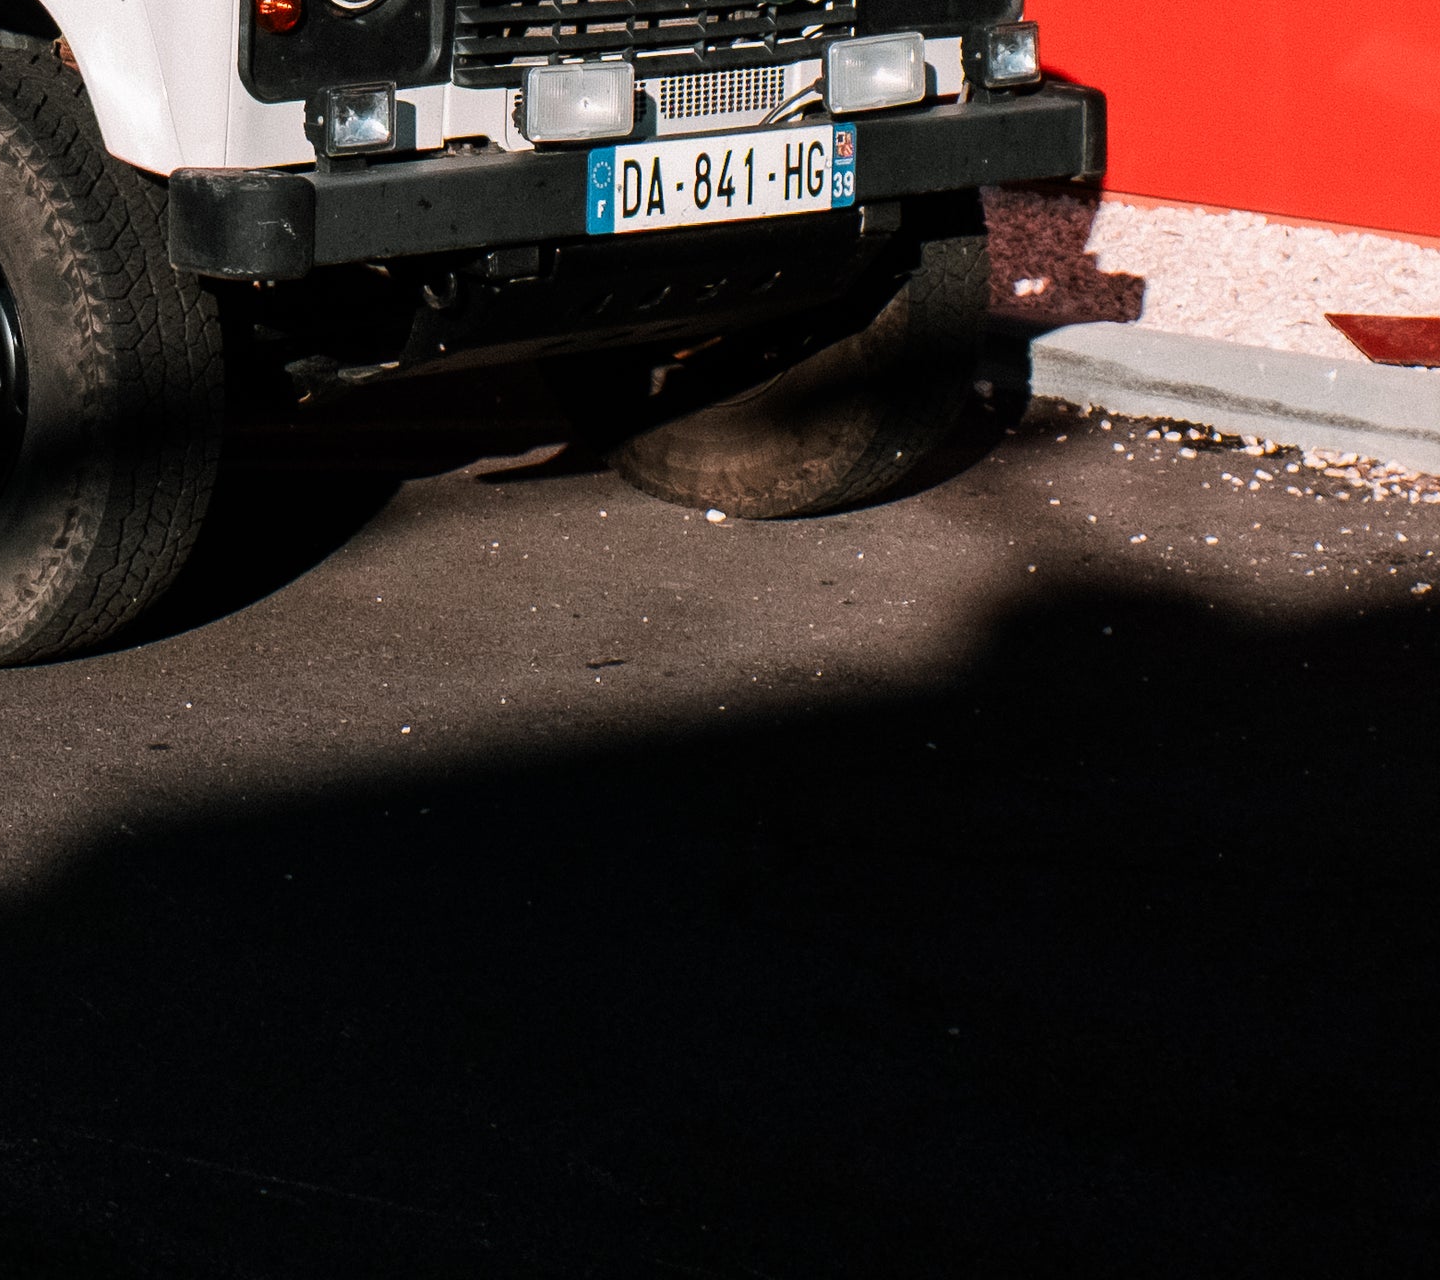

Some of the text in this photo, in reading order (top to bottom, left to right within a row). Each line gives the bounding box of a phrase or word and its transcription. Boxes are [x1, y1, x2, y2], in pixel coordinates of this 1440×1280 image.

[622, 140, 825, 219] DA-841-HG
[832, 170, 856, 199] 39
[596, 198, 608, 219] F
